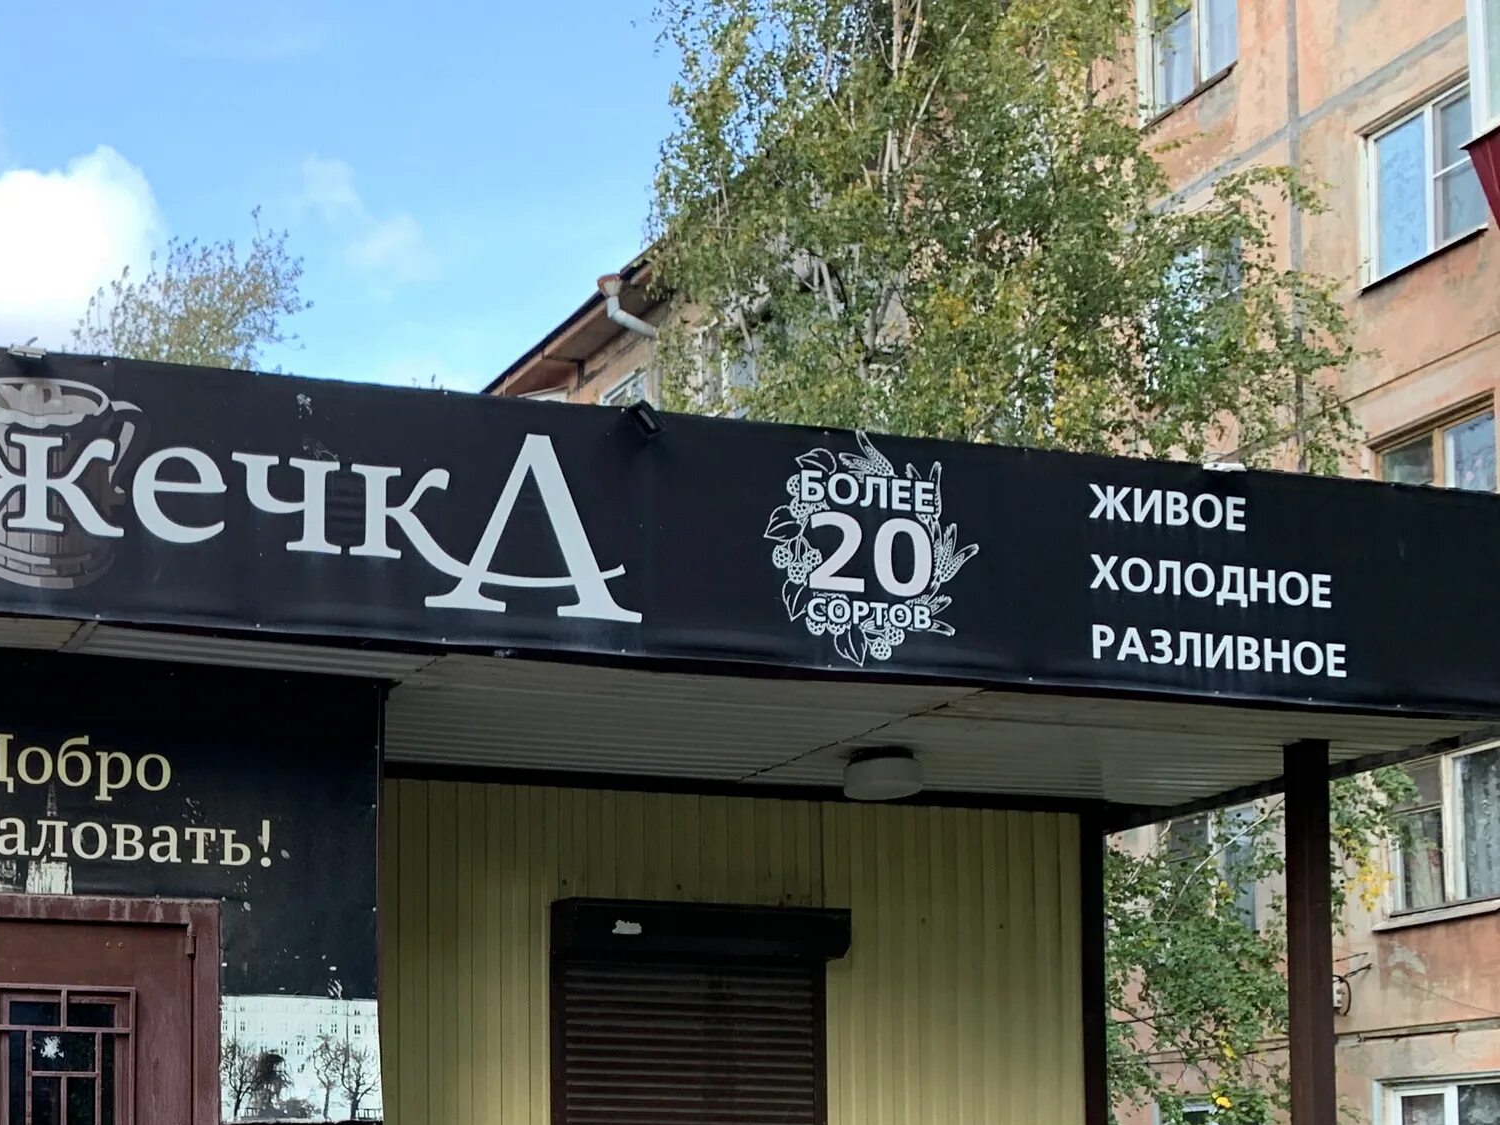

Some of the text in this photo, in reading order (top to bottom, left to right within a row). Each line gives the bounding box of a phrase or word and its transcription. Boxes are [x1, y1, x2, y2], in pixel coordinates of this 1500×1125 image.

[799, 469, 935, 513] БОЛЕЕ
[1089, 483, 1246, 532] ЖИВОЕ
[809, 511, 932, 597] 20
[1090, 553, 1332, 608] ХОЛОДНОЕ
[807, 597, 932, 630] СОРТОВ
[1091, 624, 1347, 678] РАЗЛИВНОЕ
